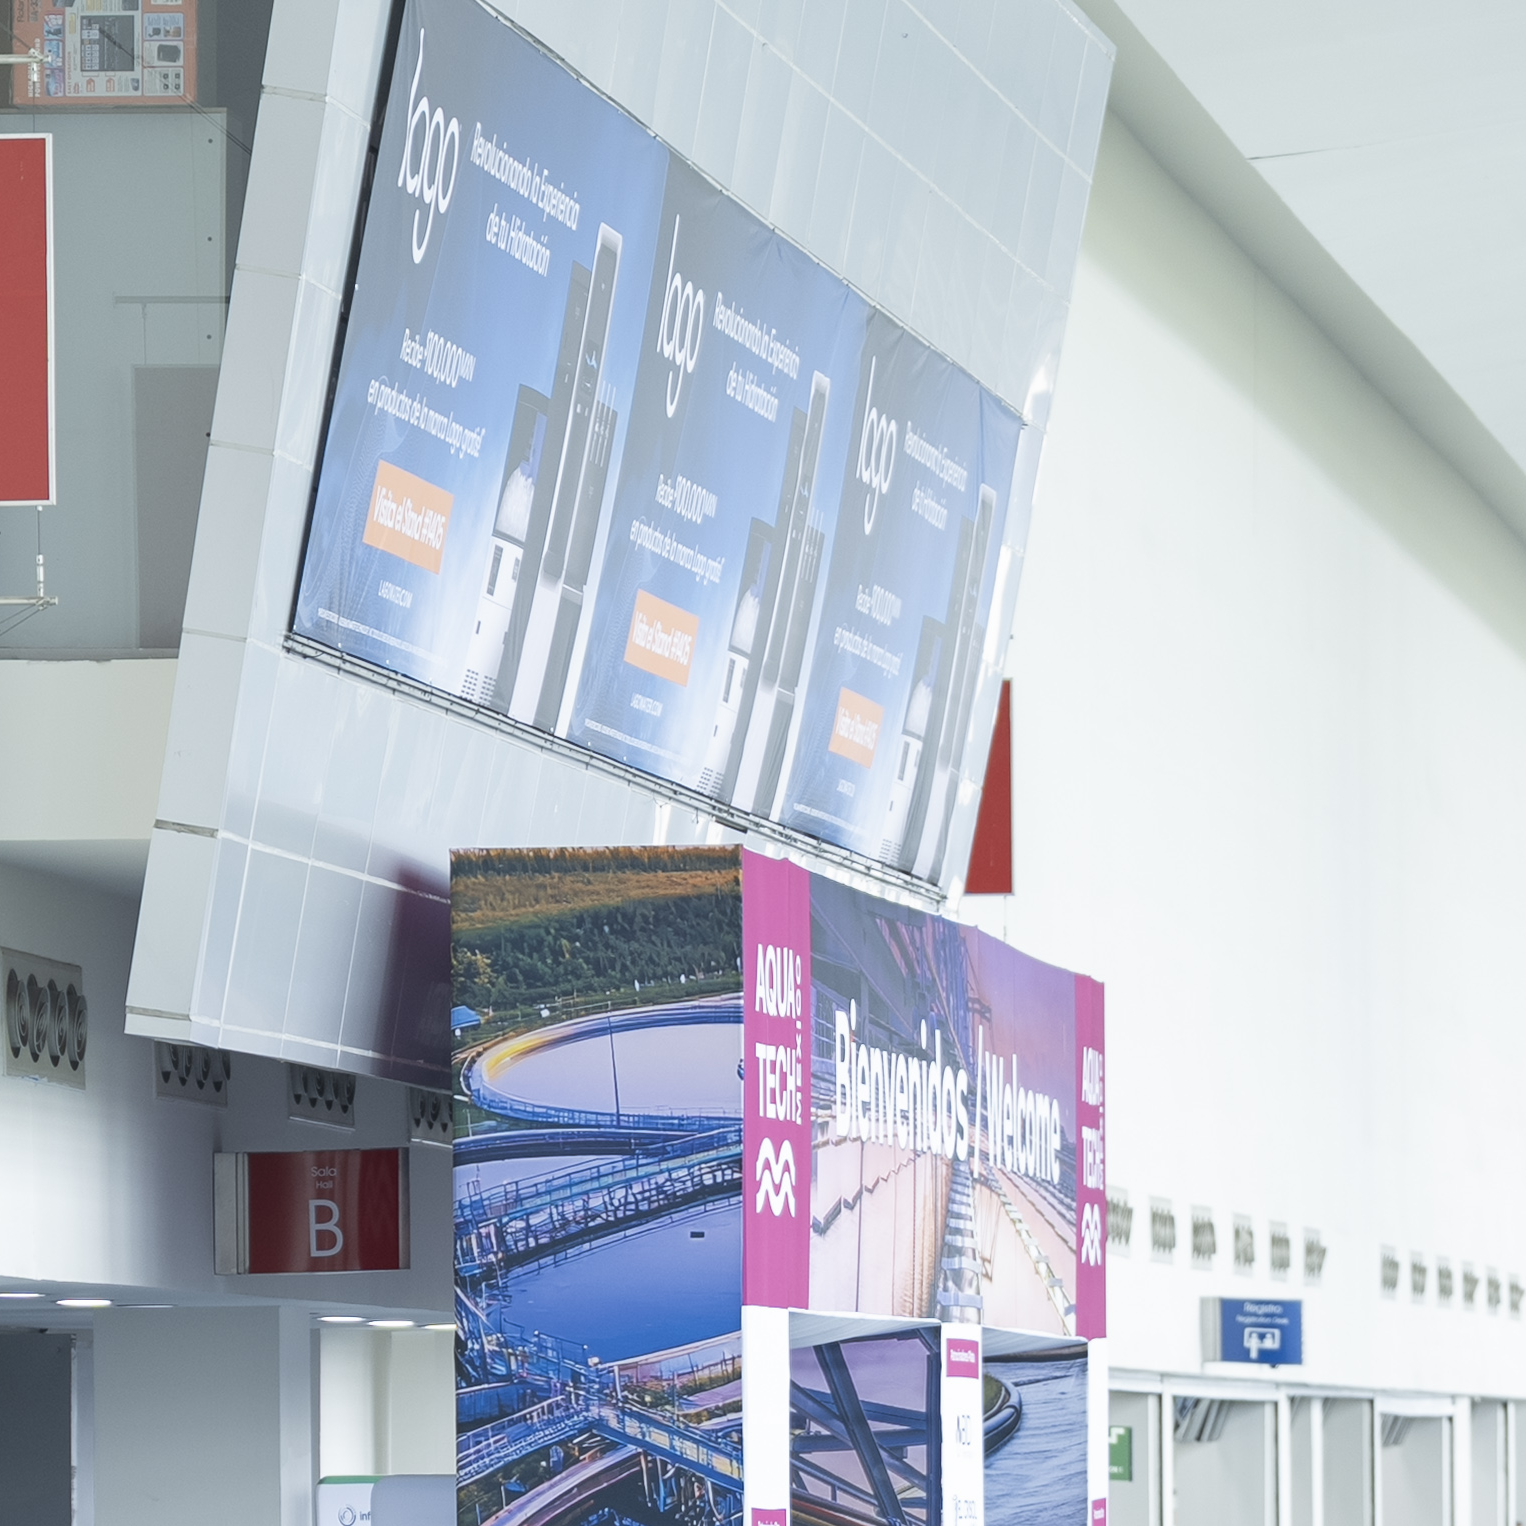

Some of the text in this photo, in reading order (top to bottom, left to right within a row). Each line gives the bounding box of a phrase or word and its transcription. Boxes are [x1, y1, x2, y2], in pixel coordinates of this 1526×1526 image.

[398, 28, 461, 264] lago
[471, 122, 531, 198] Revolucionando
[538, 169, 580, 230] Experiencia
[507, 215, 550, 276] Hidratación
[400, 328, 423, 368] Recibe
[657, 215, 704, 418] lago
[856, 356, 897, 535] lago
[374, 486, 397, 528] Visita
[402, 500, 425, 540] Stand
[420, 510, 445, 549] #1405
[755, 944, 796, 1019] AQUA
[755, 1042, 796, 1122] TECH
[835, 998, 969, 1162] Bienvenidos
[985, 1051, 1061, 1186] Welcome
[311, 1166, 337, 1177] Sala
[316, 1181, 333, 1189] Hall
[309, 1199, 343, 1257] B
[1243, 1302, 1283, 1315] Registro
